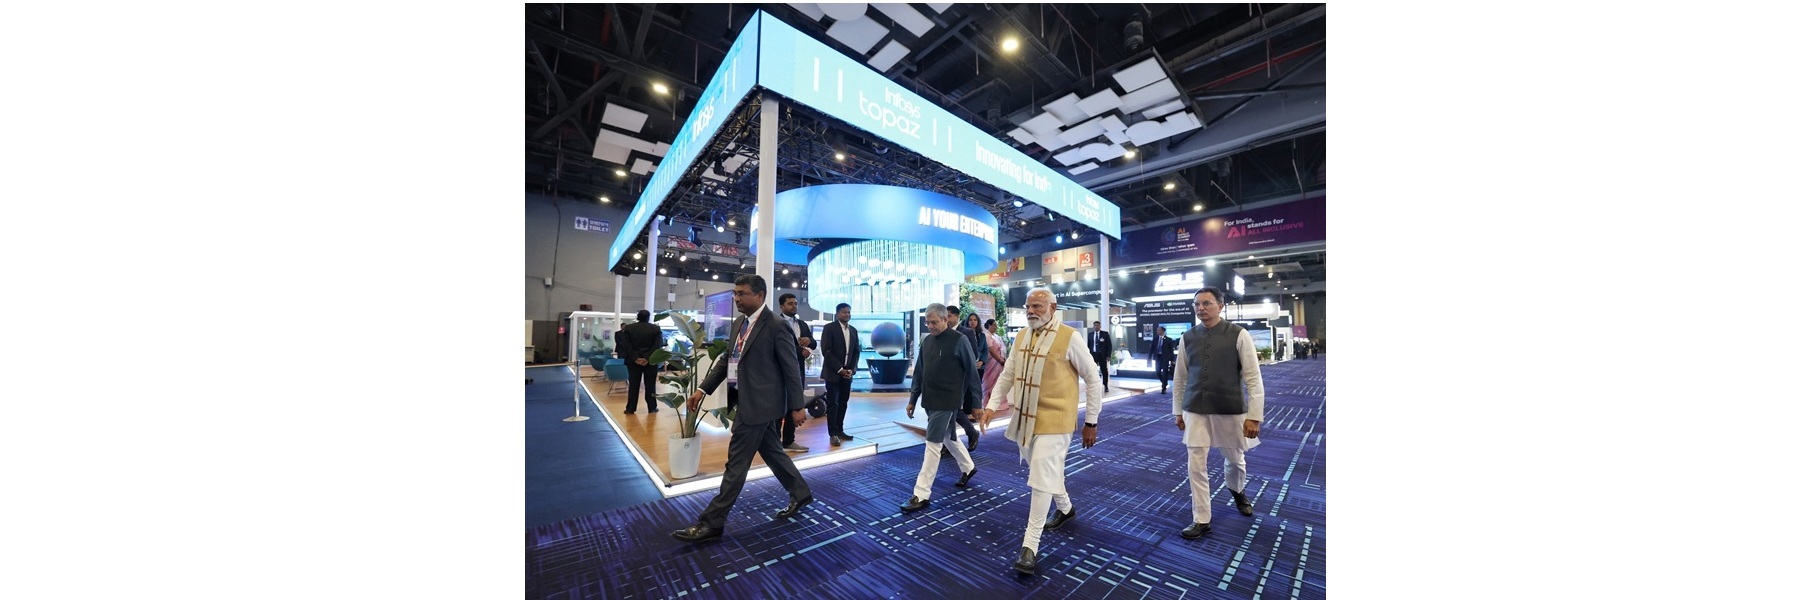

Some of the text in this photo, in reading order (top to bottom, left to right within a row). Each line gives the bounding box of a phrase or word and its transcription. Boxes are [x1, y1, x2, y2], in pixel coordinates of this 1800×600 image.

[859, 90, 920, 139] topaz
[885, 86, 921, 119] Infosys
[975, 140, 1022, 184] Innovating
[1023, 165, 1034, 187] for
[919, 206, 931, 226] AI
[933, 208, 959, 232] YOUR
[1227, 225, 1246, 239] AI
[1247, 220, 1272, 229] stands
